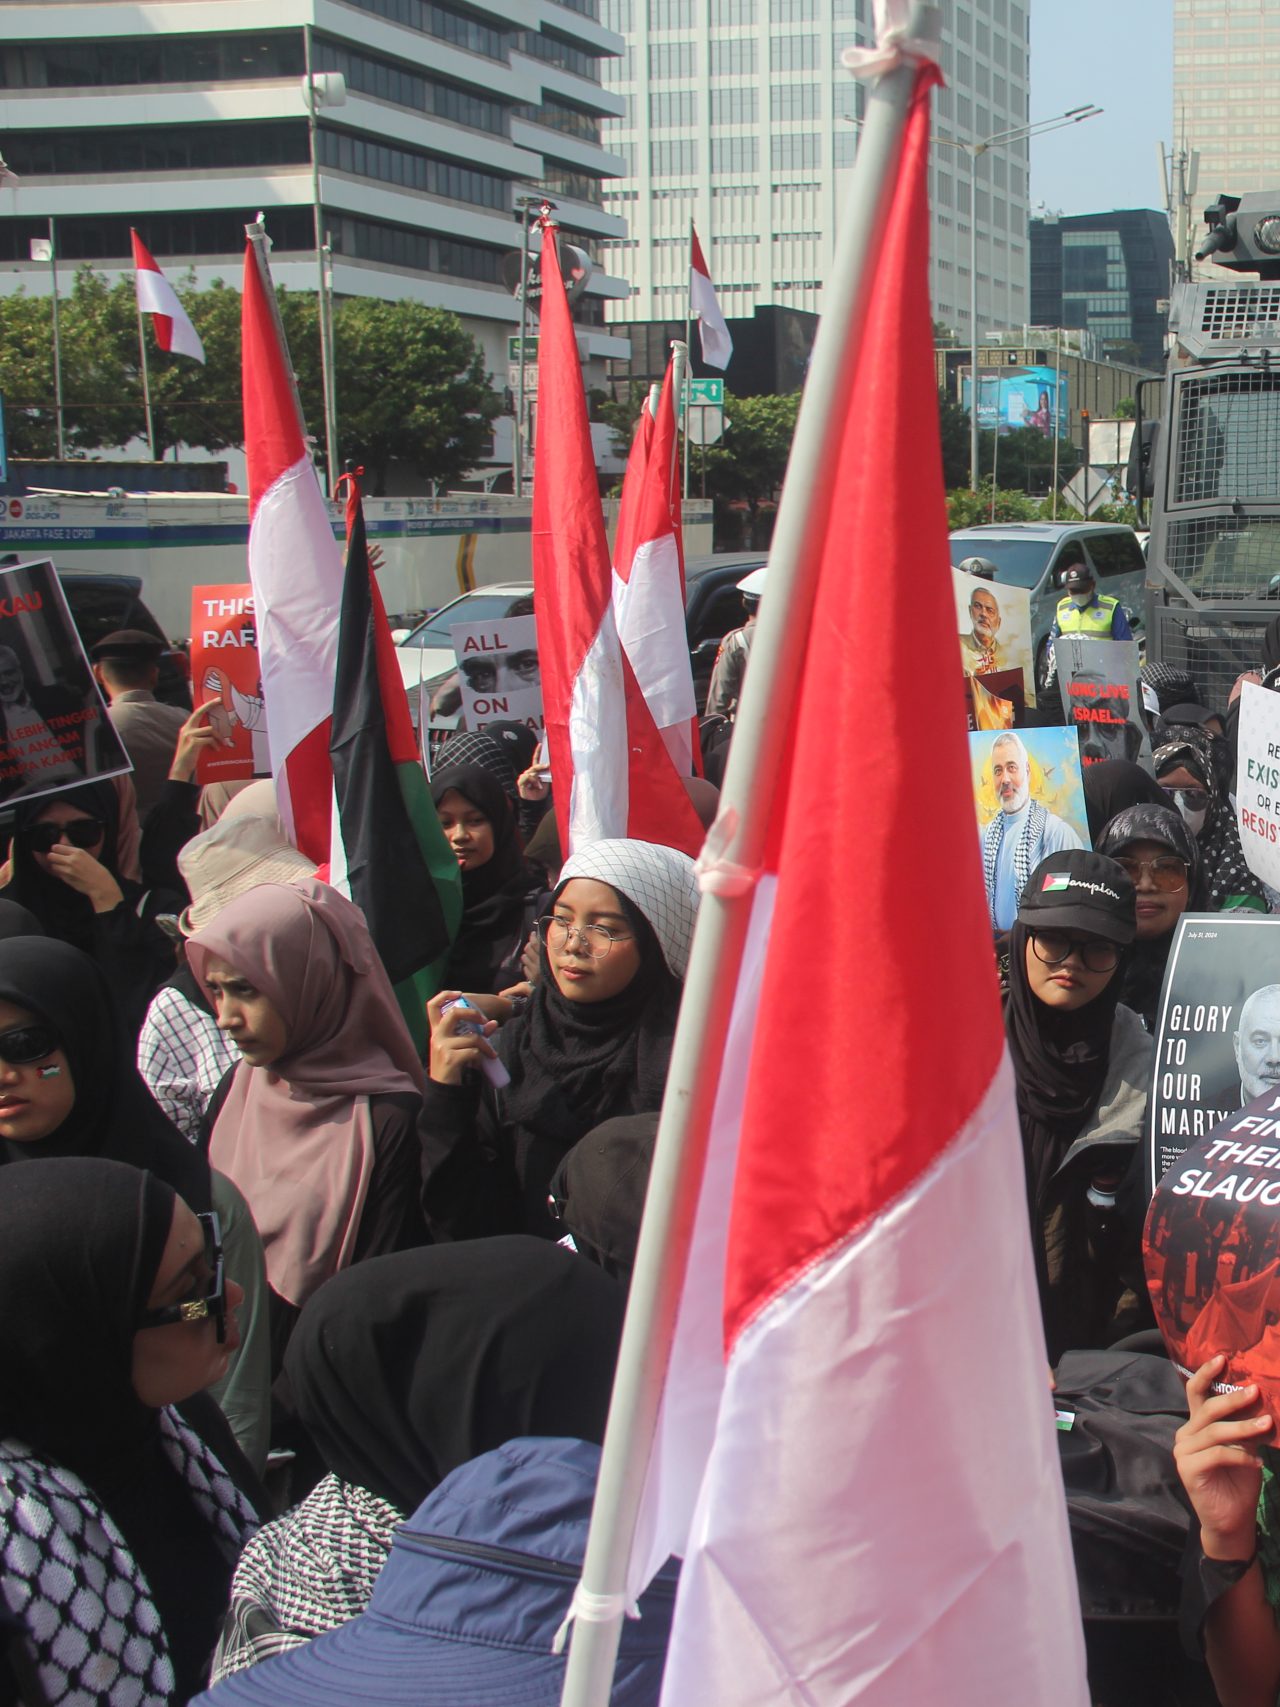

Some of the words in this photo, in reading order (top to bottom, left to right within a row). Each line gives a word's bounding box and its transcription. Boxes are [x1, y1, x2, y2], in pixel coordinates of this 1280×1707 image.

[3, 528, 41, 540] JAKARTA
[43, 528, 65, 539] FASE
[65, 528, 72, 539] 2
[203, 629, 258, 649] RAF
[463, 633, 508, 653] ALL
[1066, 681, 1097, 697] LONG
[1099, 683, 1130, 699] LIVE
[473, 697, 509, 715] ON
[1247, 758, 1280, 790] EXIS
[1257, 794, 1271, 812] OR
[1068, 878, 1121, 900] ampion
[1187, 931, 1197, 940] July
[1170, 1005, 1233, 1033] GLORY
[1166, 1038, 1187, 1066] TO
[1162, 1072, 1201, 1102] OUR
[1161, 1107, 1230, 1137] MARTY
